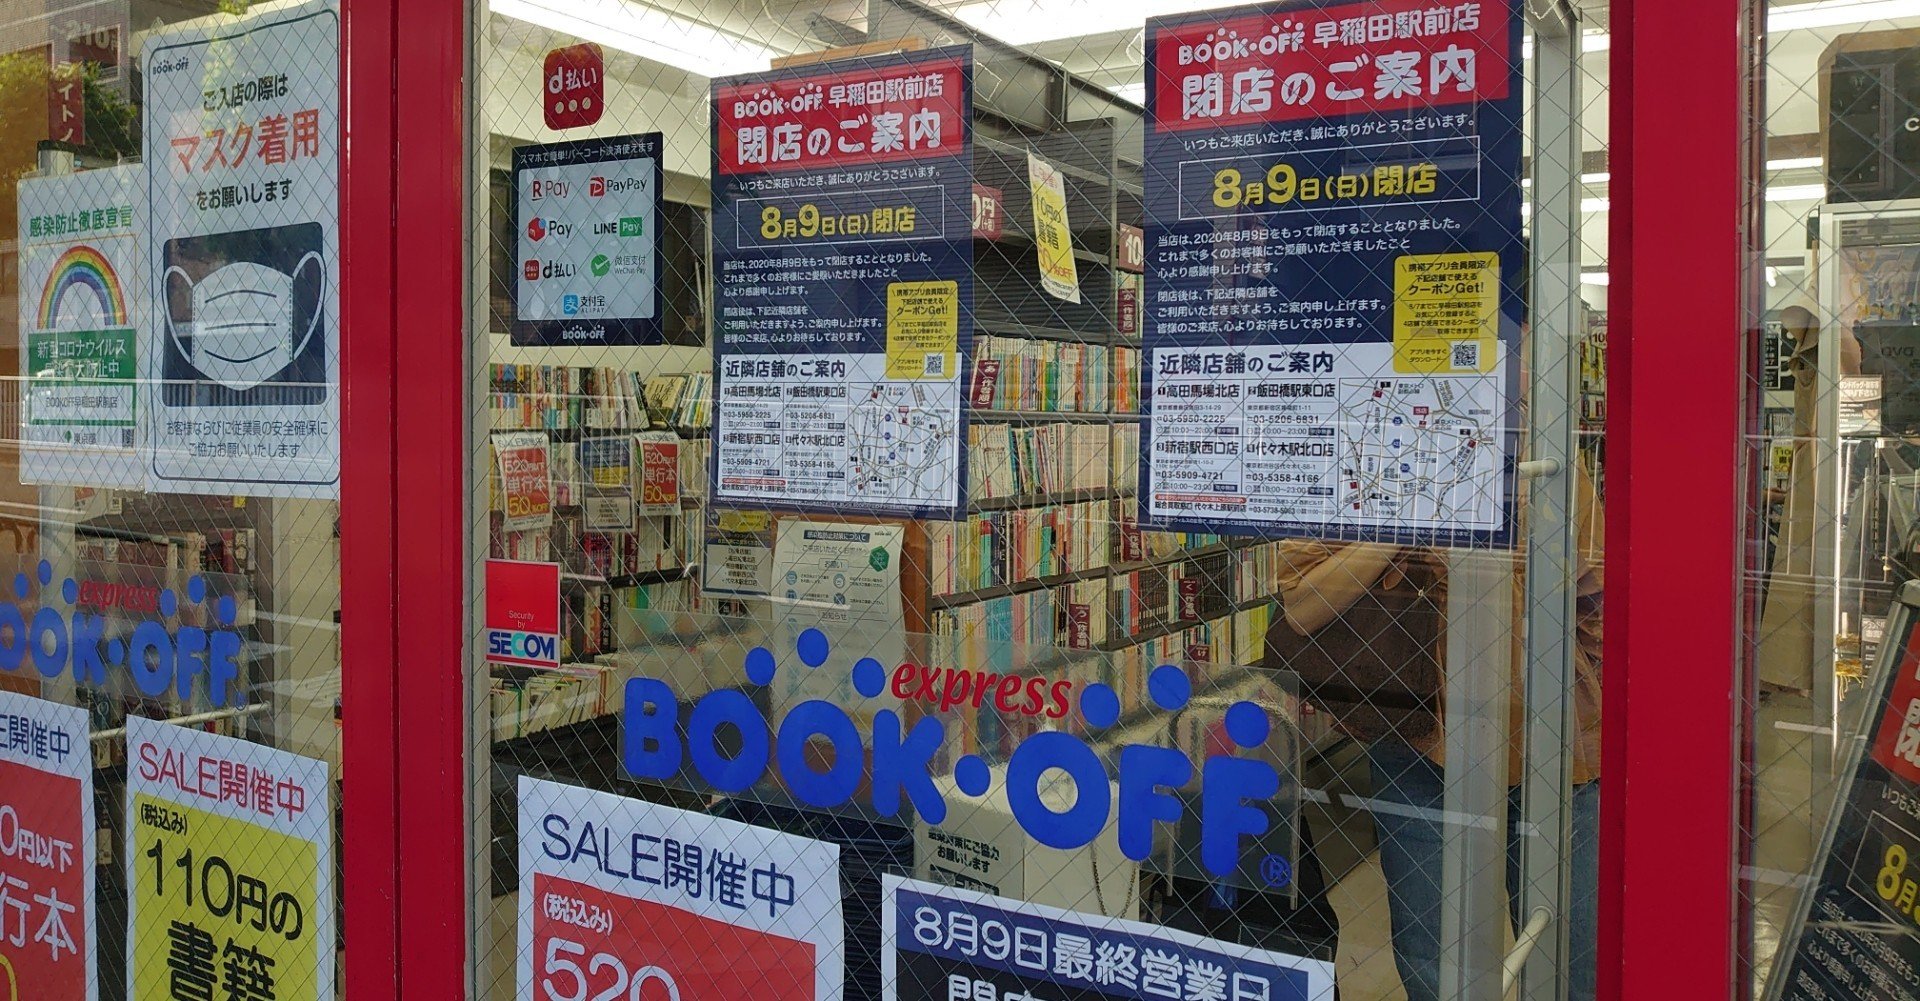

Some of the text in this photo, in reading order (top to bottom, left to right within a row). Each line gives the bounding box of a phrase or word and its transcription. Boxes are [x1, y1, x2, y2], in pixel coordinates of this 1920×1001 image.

[1312, 3, 1481, 49] 早稲田駅前店
[549, 66, 598, 94] d払い
[1182, 44, 1476, 120] 閉店のご案内
[204, 74, 289, 110] ご入店の際は
[828, 73, 944, 109] 早稲田駅前店
[171, 109, 320, 174] マスク着用
[737, 108, 942, 165] 閉店のご案内
[1184, 112, 1475, 152] いつもご来店いただき、誠にありがとうございます。
[545, 179, 570, 199] Pay
[606, 177, 647, 194] PayPay
[740, 167, 942, 191] いつもご来店いただき、誠にありがとうございます。
[1212, 163, 1438, 208] 8月9日(日)閉店
[196, 178, 292, 211] をお願いします
[30, 206, 133, 238] 感染防止徹底宣言
[548, 220, 573, 238] Pay
[594, 221, 641, 234] LINE Pay
[760, 204, 916, 240] 8月9日(日)閉店
[1158, 219, 1461, 248] 当店は、2020年8月9日をもって閉店することとなりました。
[1158, 238, 1411, 263] これまで多くのお客様にご愛顧いただきましたこと
[542, 260, 576, 279] d払い
[1158, 262, 1279, 279] 心より感謝申し上げます。
[723, 284, 810, 298] 心より感謝申し上げます。
[1157, 286, 1278, 302] 閉店後は、下記近隣店舗を
[1408, 282, 1484, 296] クーポンGet!
[580, 295, 606, 307] 支付宝
[896, 305, 948, 316] クーポンGet!
[1157, 299, 1387, 318] ご利用いただきますよう、ご案内申し上げます。
[1157, 316, 1363, 334] 皆様のご来店、心よりお待ちしております。
[38, 338, 126, 358] 新型コロナウイルス
[725, 358, 846, 378] 近隣店舗のご案内
[1159, 350, 1334, 375] 近隣店舗のご案内
[730, 386, 782, 397] 高田馬場北店
[792, 386, 847, 398] 飯田橋駅東口店
[1166, 384, 1240, 398] 高田馬場北店
[1256, 384, 1335, 398] 飯田橋駅東口店
[167, 419, 328, 438] お客様ならびに従業員の安全確保に
[1162, 415, 1226, 423] 03-5950-2225
[729, 433, 780, 445] 新宿駅西口店
[792, 435, 845, 447] 代々木駅北口店
[1164, 441, 1239, 455] 新宿駅西口店
[1256, 443, 1334, 456] 代々木駅北口店
[507, 475, 546, 495] 単行本
[645, 467, 676, 484] 単行本
[1161, 471, 1223, 480] 03-5909-4721
[1252, 474, 1319, 483] 03-5358-4166
[79, 580, 158, 613] express
[508, 610, 535, 620] Security
[516, 619, 526, 629] by
[489, 631, 555, 660] SECOM
[890, 658, 1072, 720] express
[139, 742, 305, 823] SALE開催中
[141, 802, 188, 838] (税込み)
[541, 813, 795, 918] SALE開催中
[937, 845, 991, 874] お願いします
[146, 838, 304, 941] 110円の
[1876, 843, 1920, 926] 8月
[543, 892, 613, 936] (税込み)
[167, 920, 277, 1001] 書籍
[913, 905, 1270, 1001] 8月9日最終営業日
[543, 936, 681, 1001] 520
